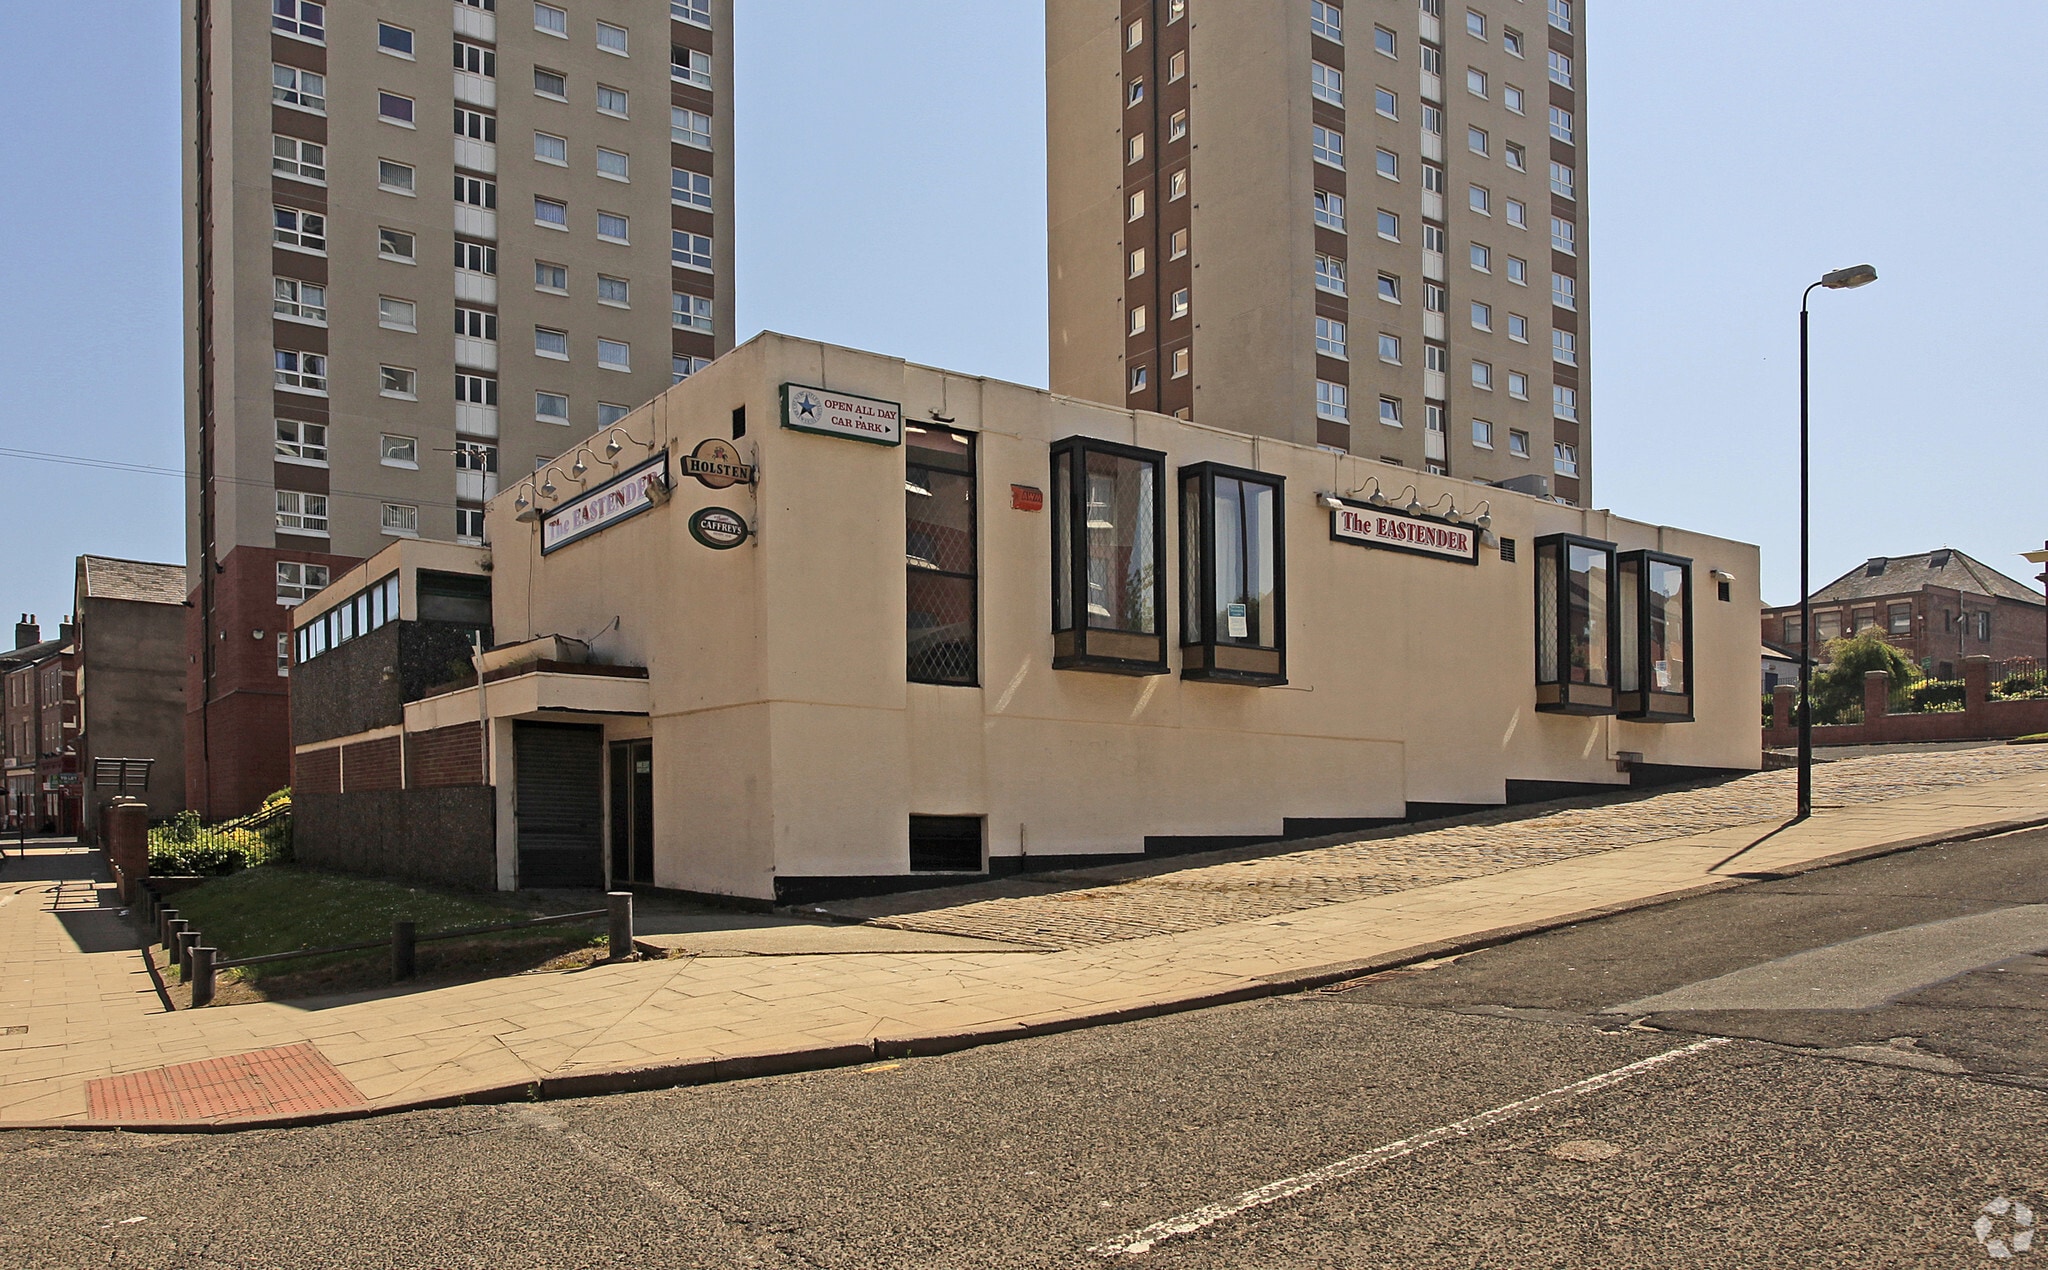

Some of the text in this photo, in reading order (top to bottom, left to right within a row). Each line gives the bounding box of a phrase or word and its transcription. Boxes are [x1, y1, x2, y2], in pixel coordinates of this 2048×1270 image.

[824, 399, 897, 420] OPEN ALL DAY
[831, 416, 883, 433] CAR PARK
[690, 460, 748, 479] HOLSTEN
[549, 518, 570, 540] The
[1341, 511, 1468, 553] The EASTENDER
